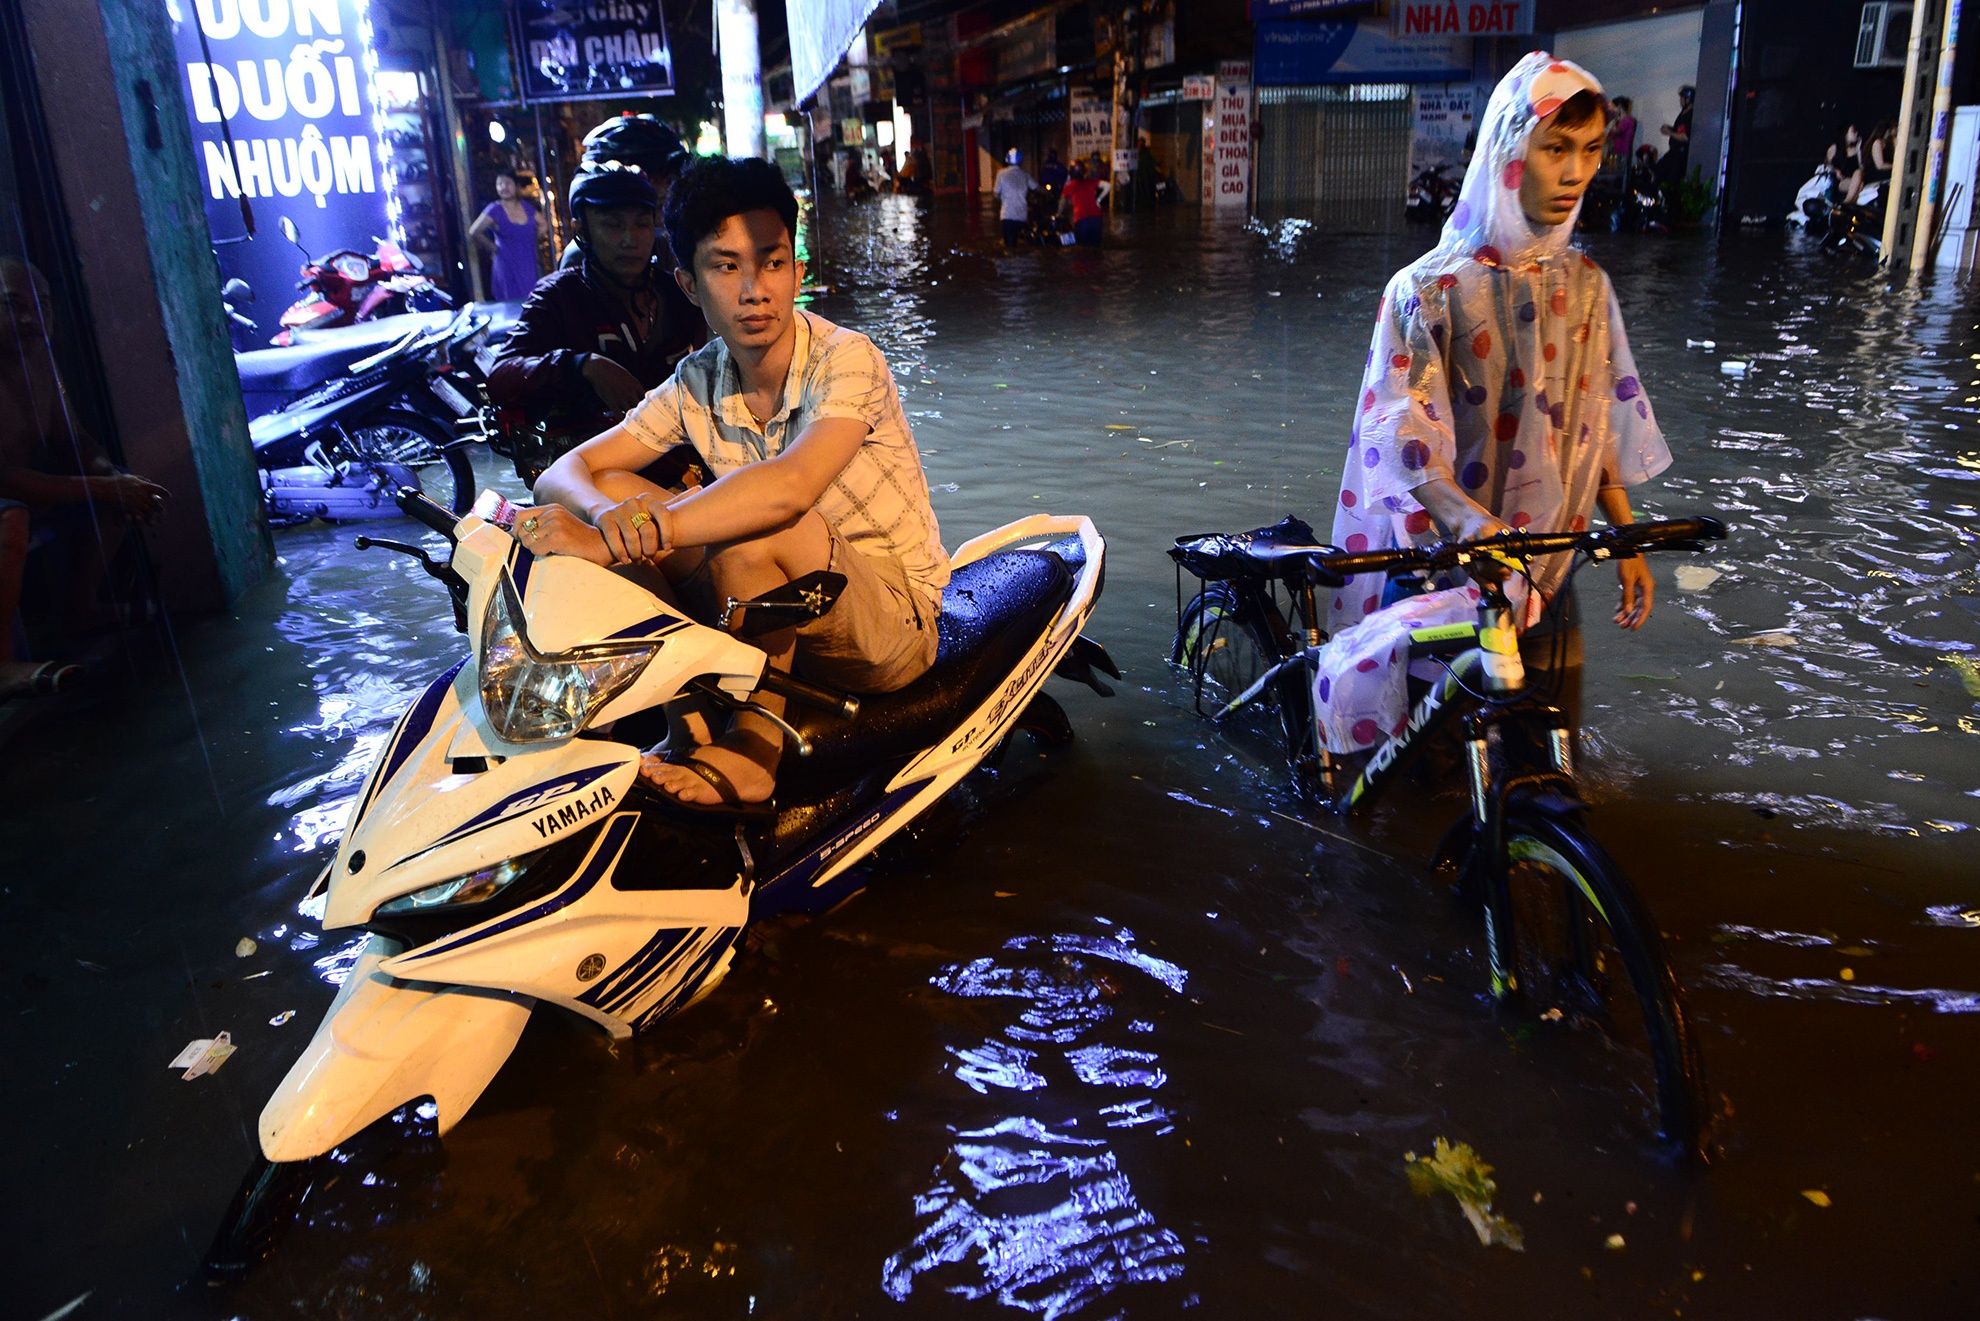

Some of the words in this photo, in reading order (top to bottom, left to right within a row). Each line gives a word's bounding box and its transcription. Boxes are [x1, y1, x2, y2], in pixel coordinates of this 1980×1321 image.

[187, 39, 361, 123] DUỖI
[1222, 97, 1244, 109] THU
[1222, 114, 1246, 127] MUA
[203, 124, 376, 208] NHUỘM
[1222, 181, 1244, 194] CAO
[531, 786, 616, 838] YAMAHA
